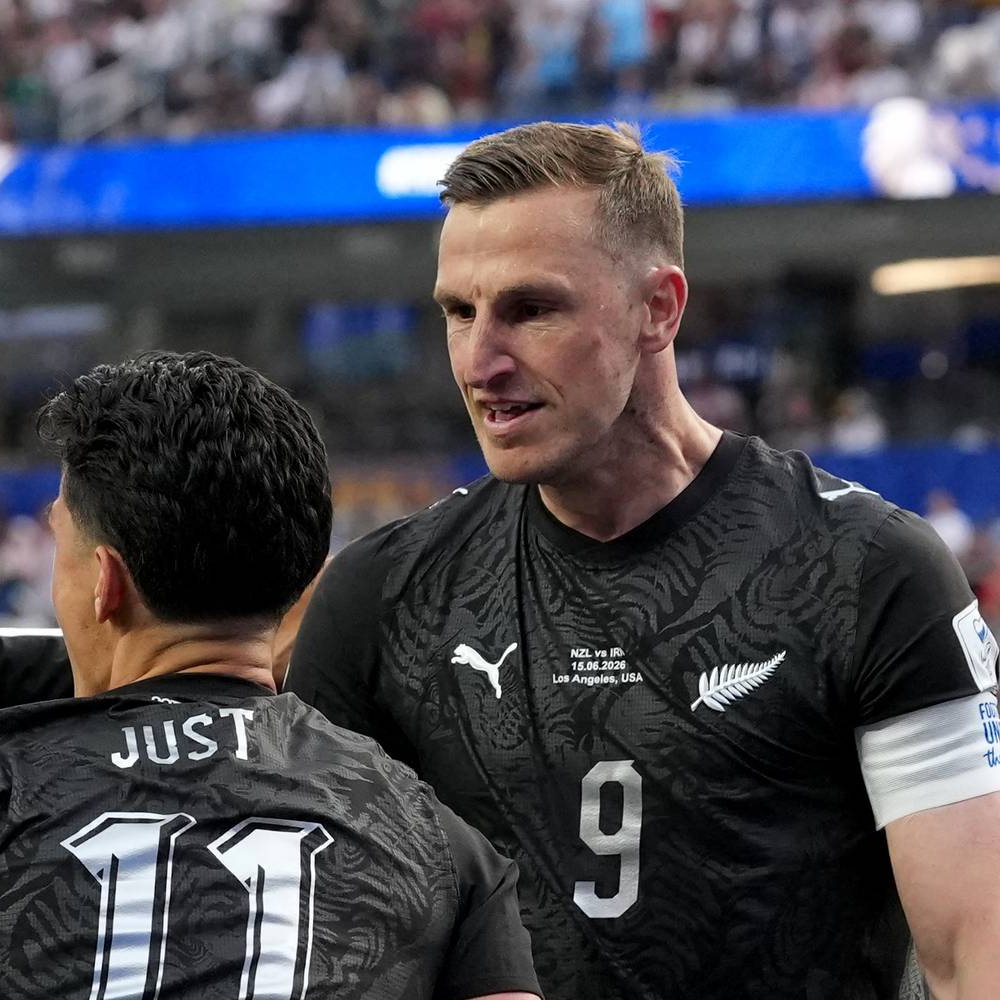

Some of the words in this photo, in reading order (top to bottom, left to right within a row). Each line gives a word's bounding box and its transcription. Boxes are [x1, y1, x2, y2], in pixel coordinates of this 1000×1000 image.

[570, 648, 591, 657] NZL
[571, 660, 625, 670] 15.06.2026
[552, 673, 569, 683] Los
[571, 674, 617, 685] Angeles,
[621, 672, 642, 682] USA
[111, 708, 254, 768] JUST
[574, 760, 643, 918] 9
